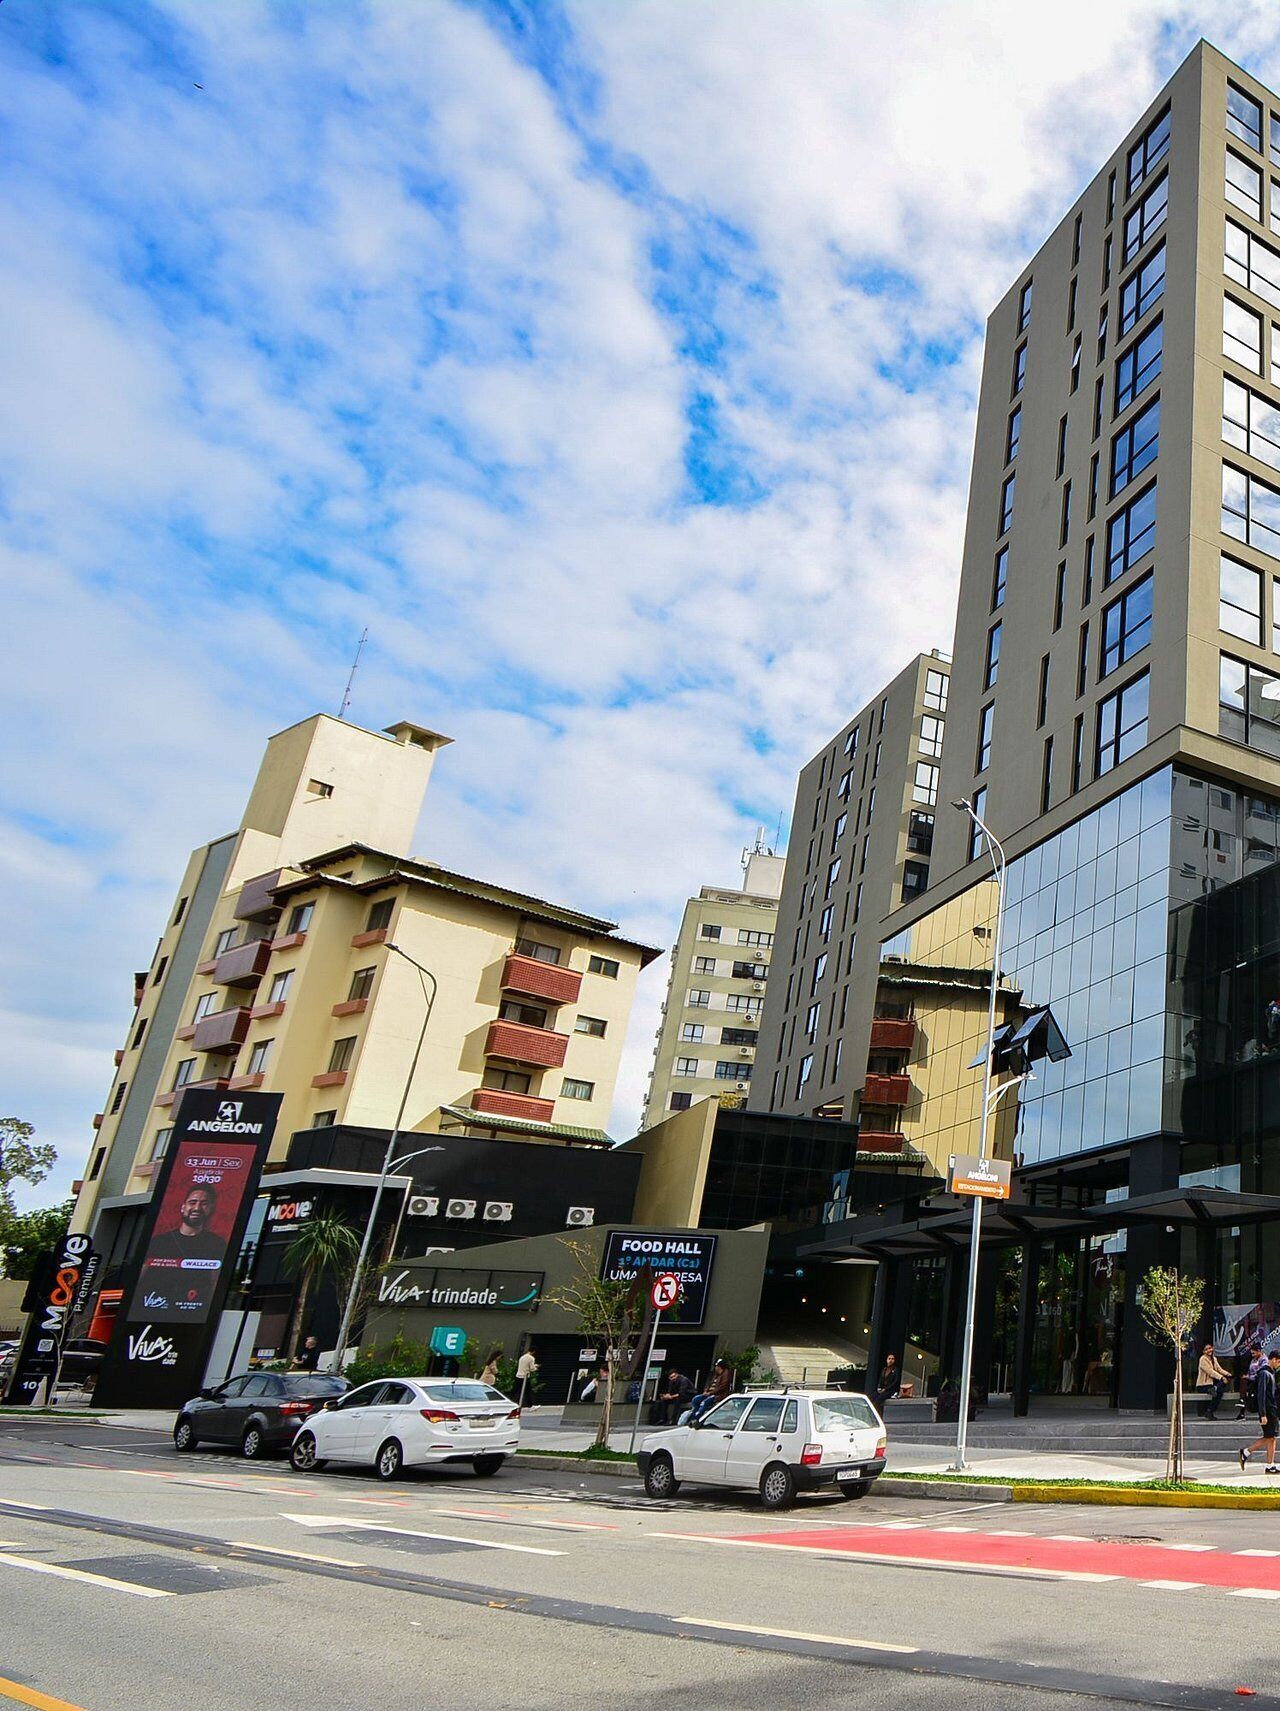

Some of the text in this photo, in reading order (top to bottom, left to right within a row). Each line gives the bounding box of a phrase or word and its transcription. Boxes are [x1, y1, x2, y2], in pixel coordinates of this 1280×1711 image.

[187, 1120, 263, 1134] ANGELONI
[187, 1159, 198, 1167] 13
[199, 1158, 217, 1166] Jun
[192, 1174, 221, 1184] 19h30
[967, 1170, 999, 1182] ANGELONI
[621, 1239, 702, 1254] FOOD HALL
[677, 1258, 700, 1269] (C1)
[610, 1269, 637, 1281] UMA
[73, 1256, 98, 1312] Premium
[431, 1288, 498, 1305] trindade
[445, 1333, 459, 1350] E
